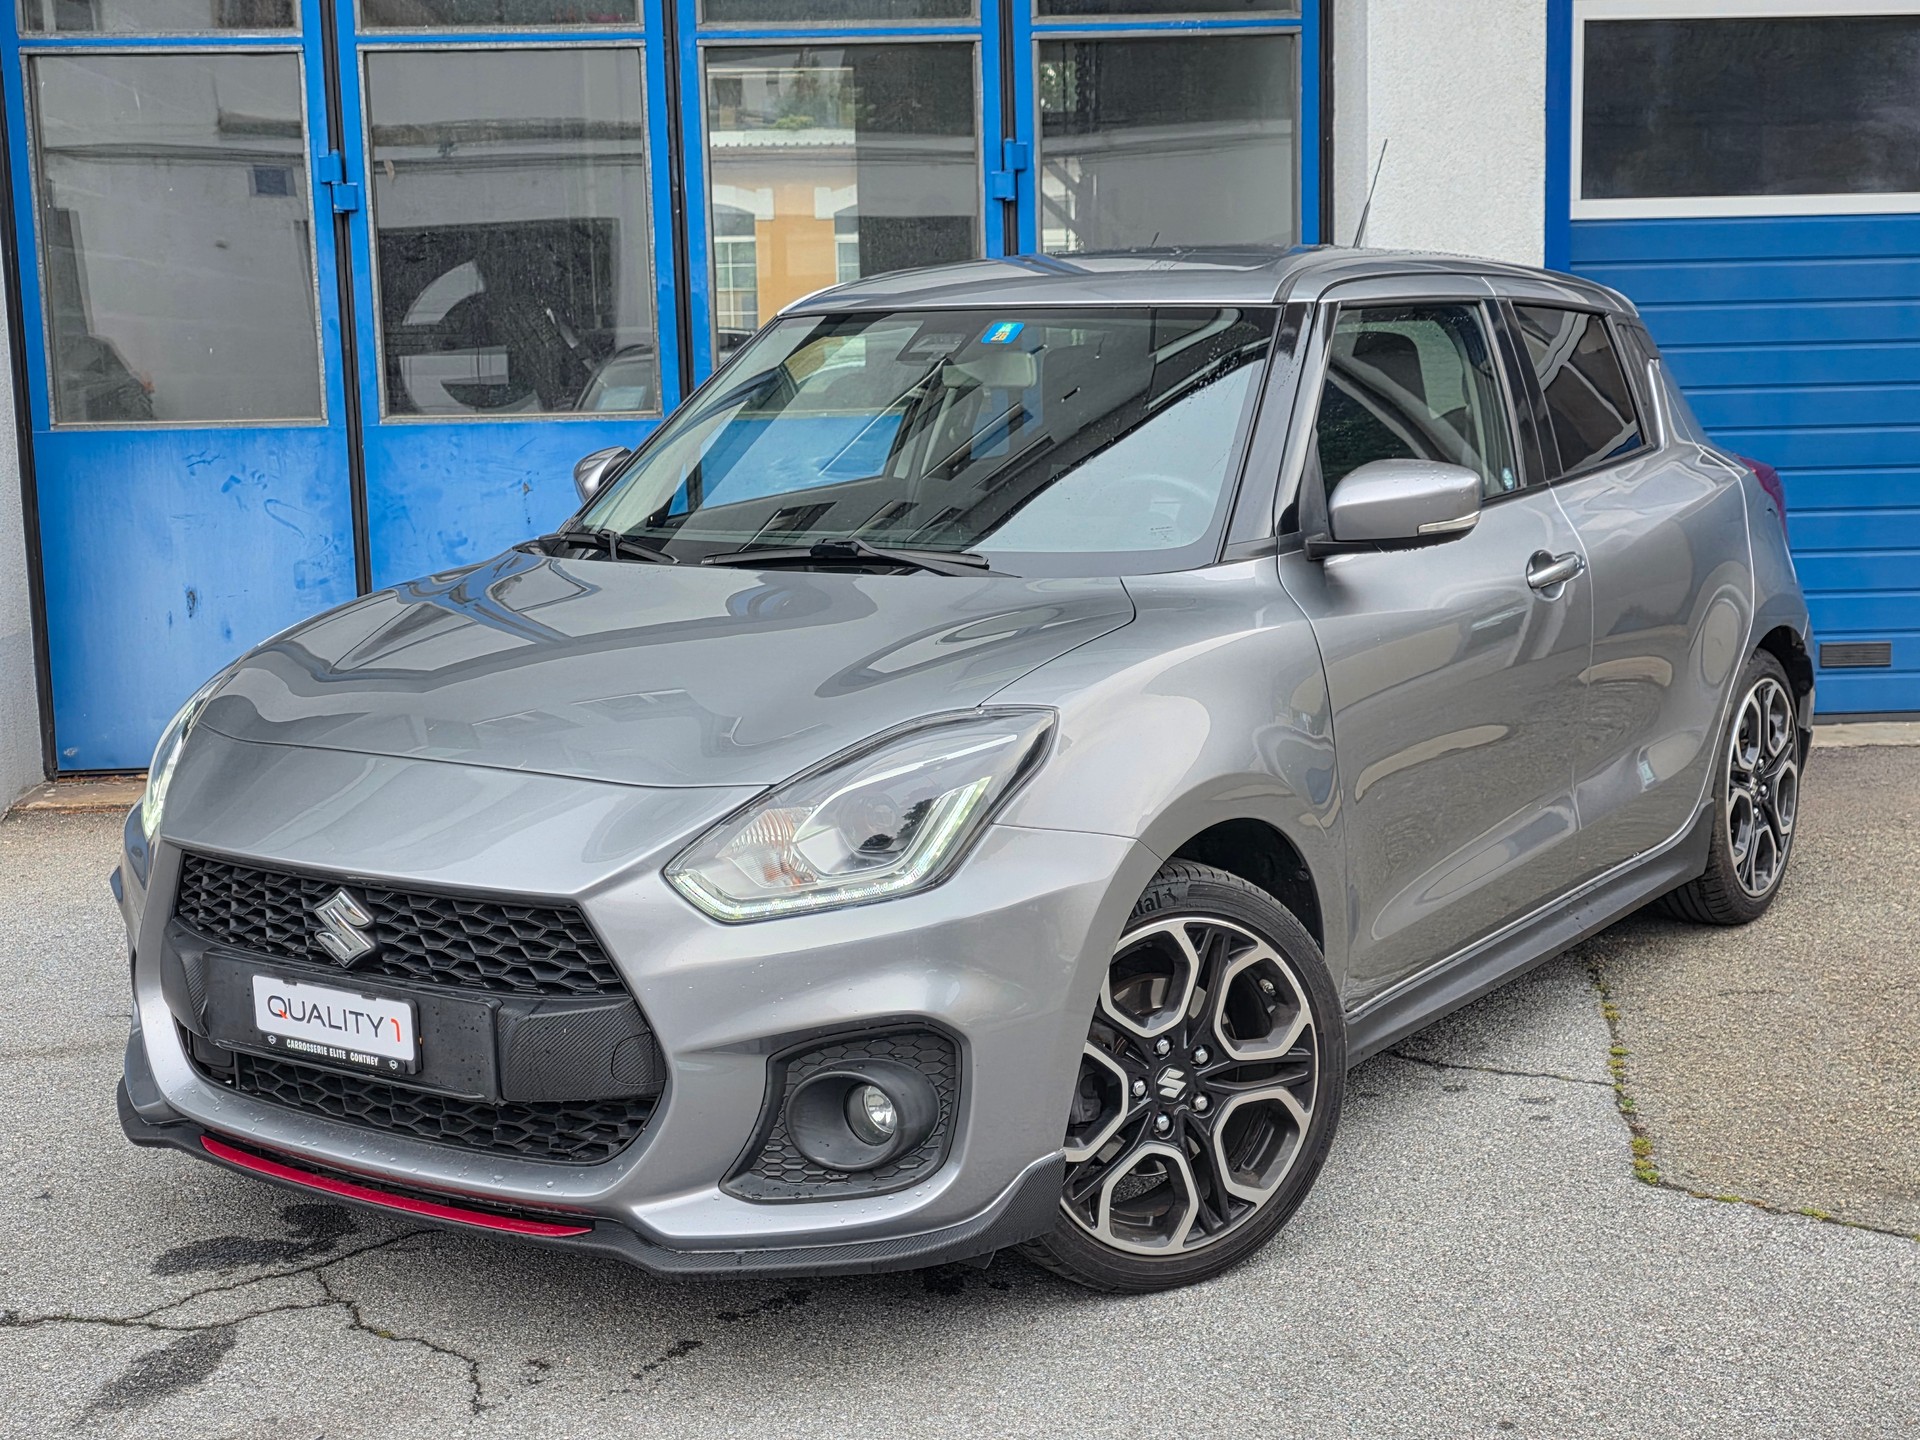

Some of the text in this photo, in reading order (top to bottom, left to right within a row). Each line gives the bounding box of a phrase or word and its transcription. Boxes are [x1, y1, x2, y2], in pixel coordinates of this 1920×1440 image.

[267, 995, 401, 1042] QUALITY 1
[286, 1039, 379, 1066] CARROSSERIE ELITE CONTHEY
